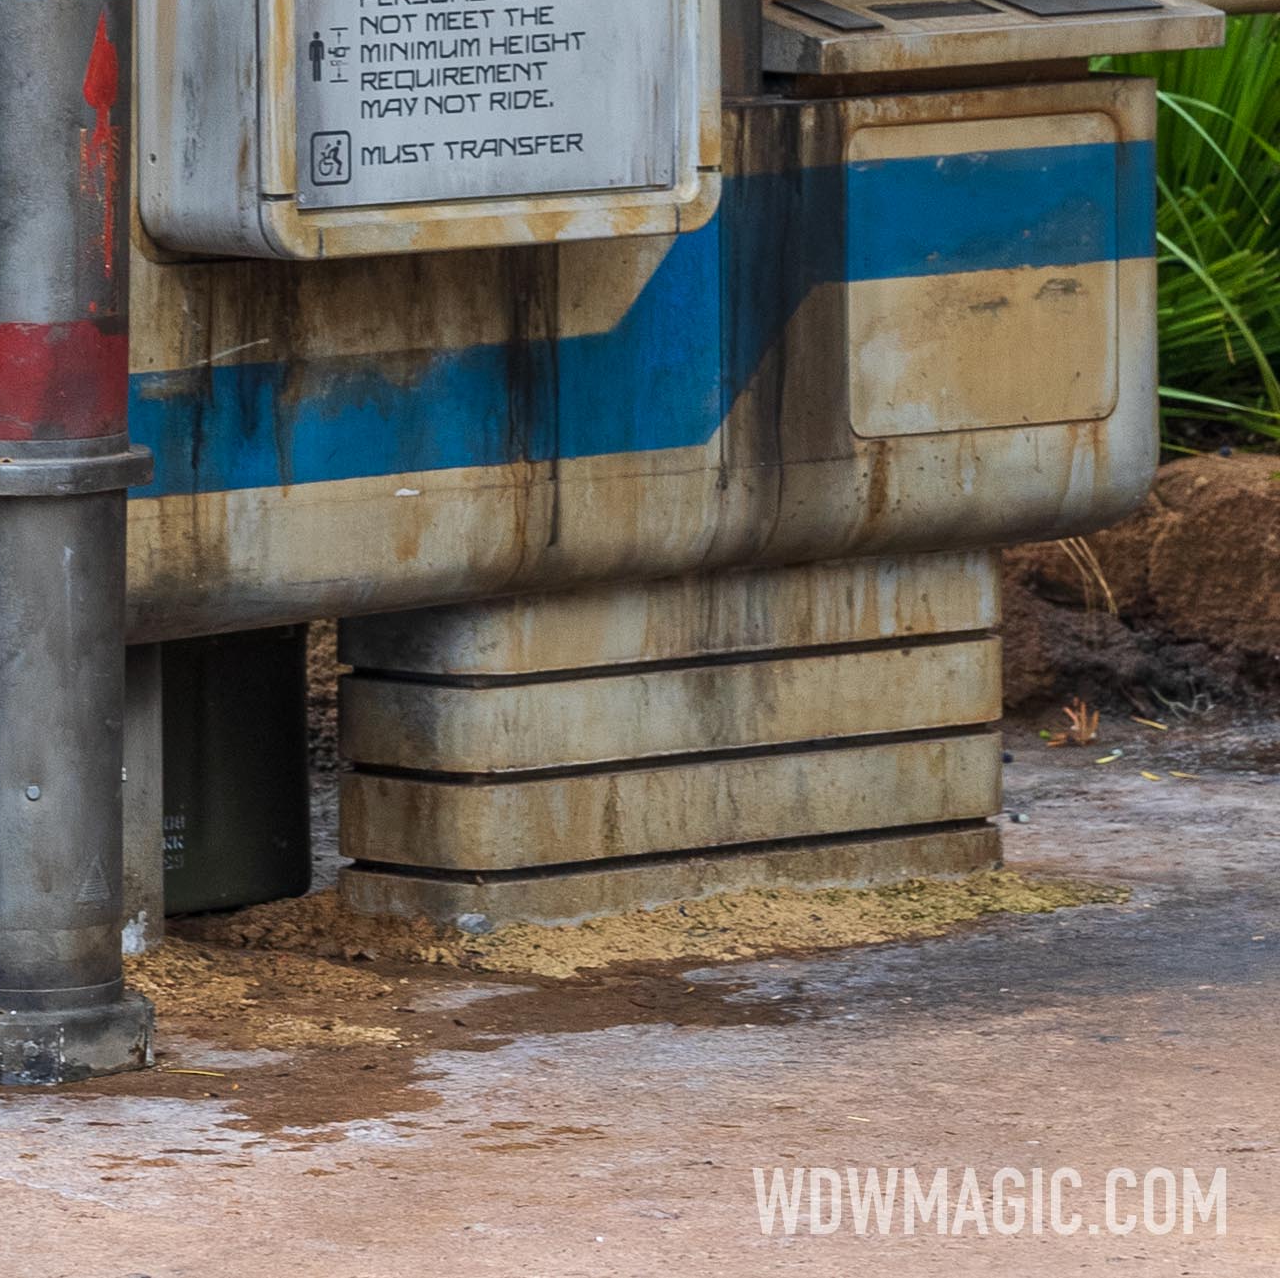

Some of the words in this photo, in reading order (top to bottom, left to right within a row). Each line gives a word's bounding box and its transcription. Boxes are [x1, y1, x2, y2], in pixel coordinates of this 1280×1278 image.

[360, 13, 418, 36] NOT
[426, 9, 495, 32] MEET
[503, 5, 554, 27] THE
[360, 37, 480, 63] MINIMUM
[489, 31, 586, 56] HEIGHT
[360, 61, 548, 92] REQUIREMENT
[361, 97, 419, 119] MAY
[424, 93, 482, 115] NOT
[489, 89, 554, 111] RIDE.
[361, 142, 435, 166] MUST
[443, 133, 584, 160] TRANSFER
